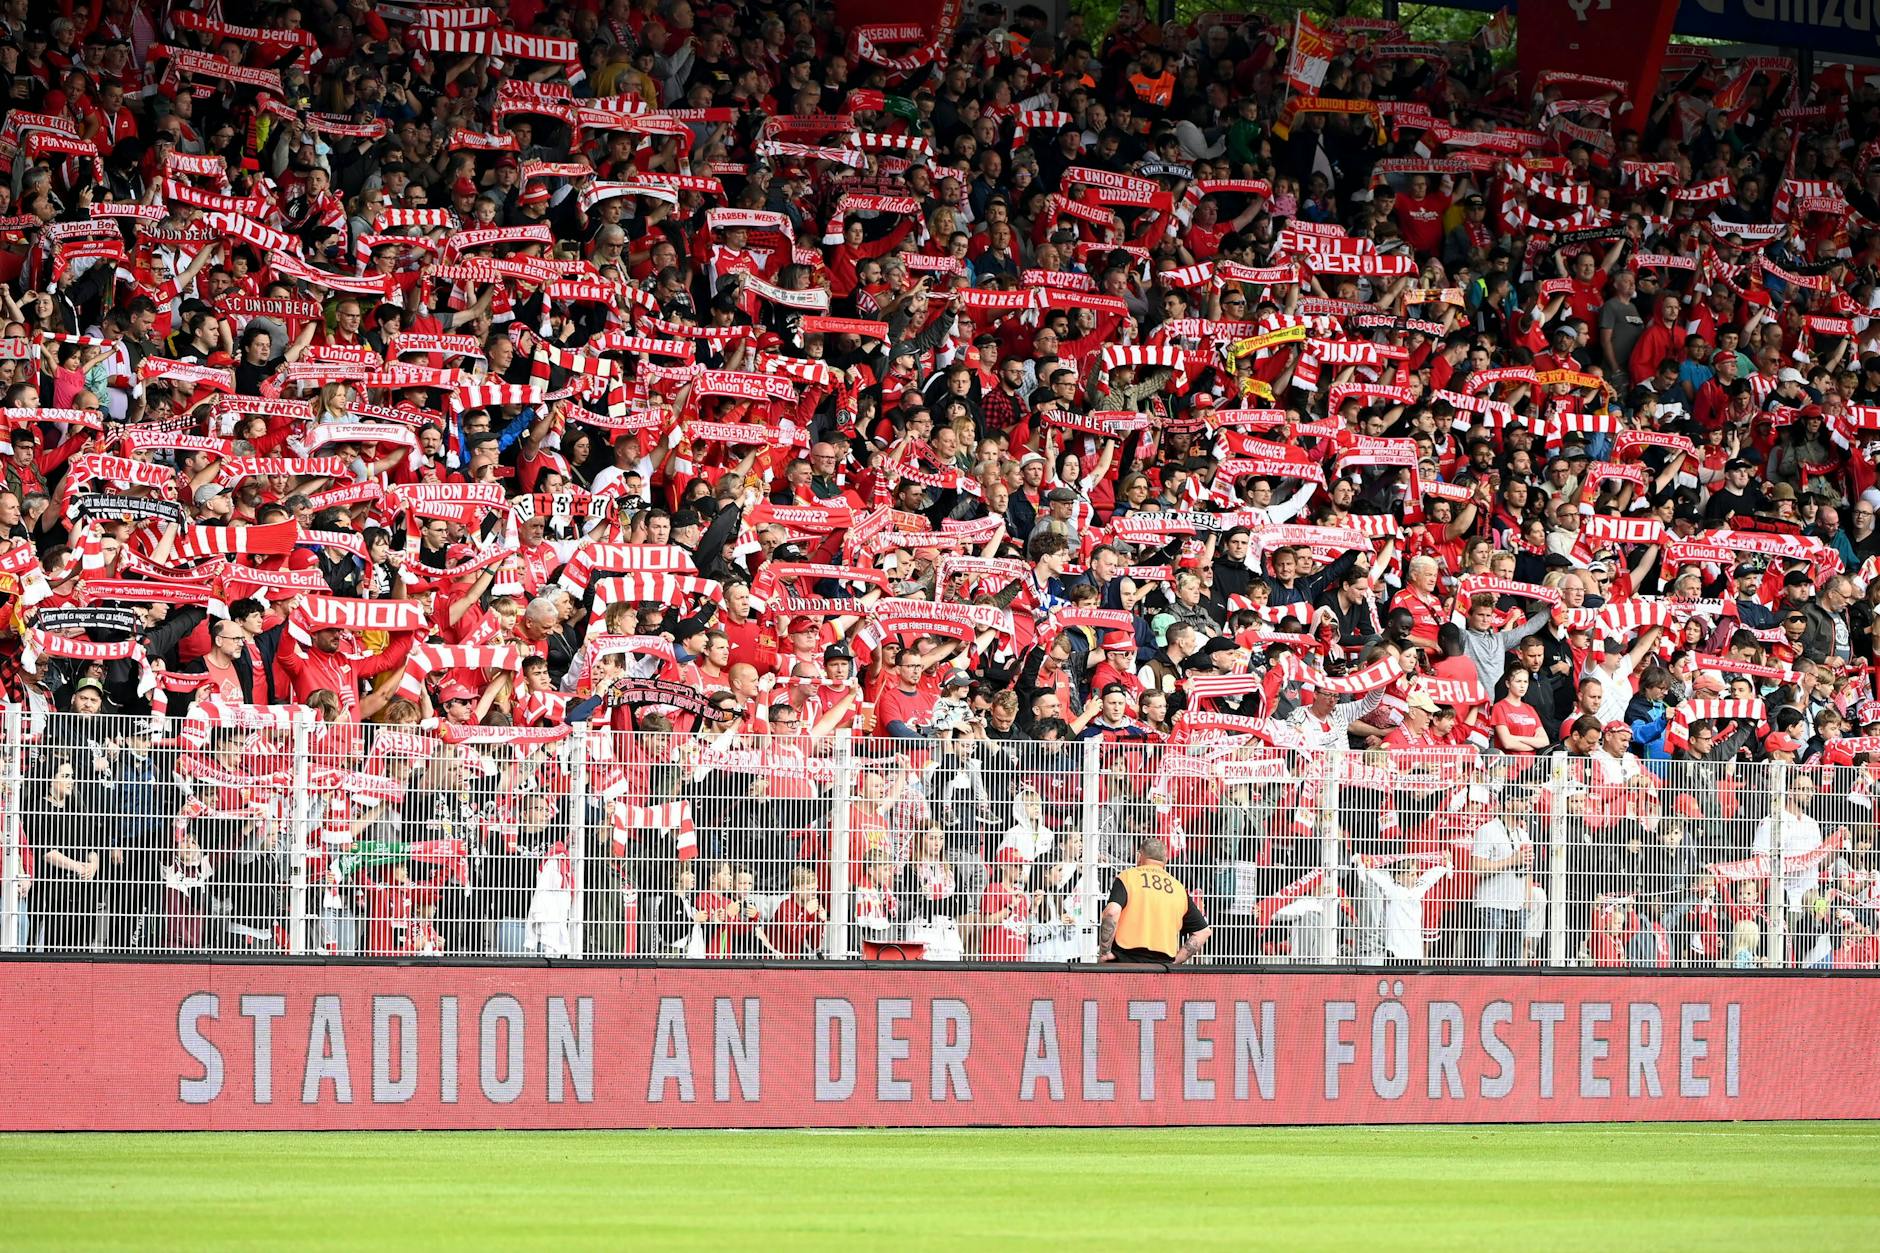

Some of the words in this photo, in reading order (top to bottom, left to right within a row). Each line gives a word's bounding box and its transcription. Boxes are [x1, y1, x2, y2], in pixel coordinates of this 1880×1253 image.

[224, 22, 258, 38] Union
[262, 23, 300, 43] Berlin
[1316, 98, 1343, 111] UNION
[1409, 116, 1432, 129] Union
[1084, 170, 1122, 188] UNION
[1099, 189, 1153, 203] UNIONER
[717, 211, 747, 222] FARBEN
[755, 212, 778, 223] WEISS
[61, 221, 92, 233] Union
[204, 211, 291, 251] NION
[1315, 223, 1345, 236] UNION
[906, 254, 935, 268] UNION
[1638, 255, 1668, 267] EISERN
[1669, 256, 1697, 270] UNION
[477, 260, 489, 270] FC
[491, 260, 522, 274] UNION
[524, 263, 559, 282] BERLIN
[962, 290, 1025, 306] UNIONER
[246, 299, 282, 314] UNION
[1811, 317, 1848, 333] UNIONER
[611, 334, 685, 355] UNIONER
[320, 346, 360, 363] Union
[1501, 367, 1538, 381] MITGLIE
[707, 380, 741, 395] Union
[742, 385, 766, 397] Ber
[624, 408, 661, 426] BERLIN
[1050, 409, 1083, 428] UNION
[1236, 411, 1259, 423] Union
[1261, 411, 1285, 423] Berlin
[1296, 423, 1338, 438] UNIONER
[1637, 431, 1669, 446] Union
[131, 430, 177, 447] EISERN
[179, 434, 224, 451] UNION
[1243, 438, 1286, 460] UNIONER
[71, 455, 133, 485] SERN
[1601, 463, 1624, 476] Union
[416, 484, 462, 501] UNION
[467, 484, 503, 504] BERL
[772, 507, 829, 523] UNIONER
[1282, 528, 1306, 539] UNION
[1311, 546, 1331, 557] EISS
[1687, 544, 1716, 558] Union
[1709, 536, 1757, 550] EISERN
[1761, 540, 1808, 558] UNION
[250, 567, 286, 585] Union
[290, 569, 327, 588] Berlin
[1129, 566, 1166, 582] Berlin
[1469, 574, 1488, 590] FC
[1492, 577, 1527, 594] Union
[302, 598, 422, 629] UNION
[788, 599, 830, 612] UNION
[933, 603, 971, 618] EINMAL
[974, 606, 989, 620] IST
[1062, 607, 1076, 618] NUR
[1077, 608, 1089, 619] FÜR
[934, 623, 949, 633] SEINE
[950, 626, 963, 636] ALTE
[51, 640, 129, 658] UNIONER
[1140, 873, 1174, 895] 188
[177, 992, 594, 1105] STADION
[648, 995, 761, 1103] AN
[814, 997, 974, 1102] DER
[1019, 999, 1276, 1102] ALTEN
[1323, 979, 1741, 1100] FÖRSTEREI
